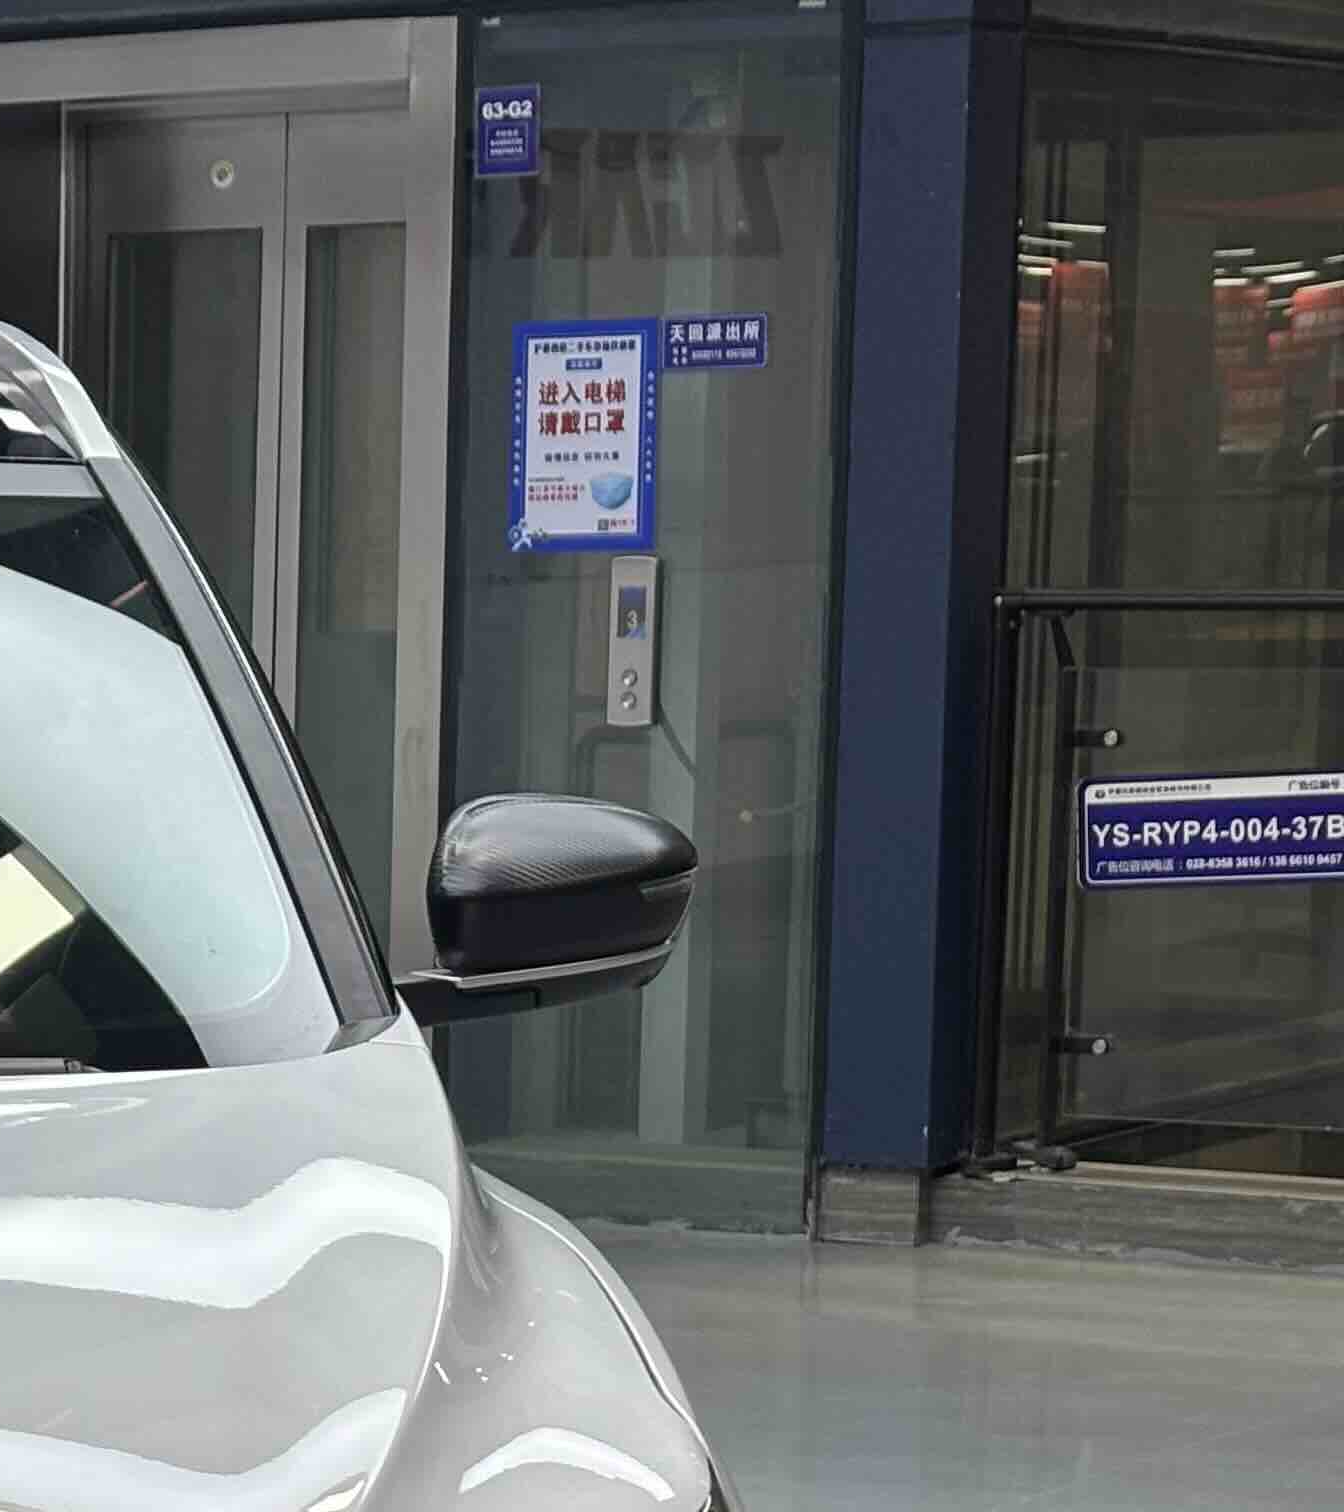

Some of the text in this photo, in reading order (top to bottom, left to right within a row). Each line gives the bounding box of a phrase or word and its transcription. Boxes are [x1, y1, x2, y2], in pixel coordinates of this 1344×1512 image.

[538, 378, 626, 406] 进入电梯
[538, 409, 626, 436] 请戴口罩
[1092, 814, 1344, 848] YS-RYP4-004-37B
